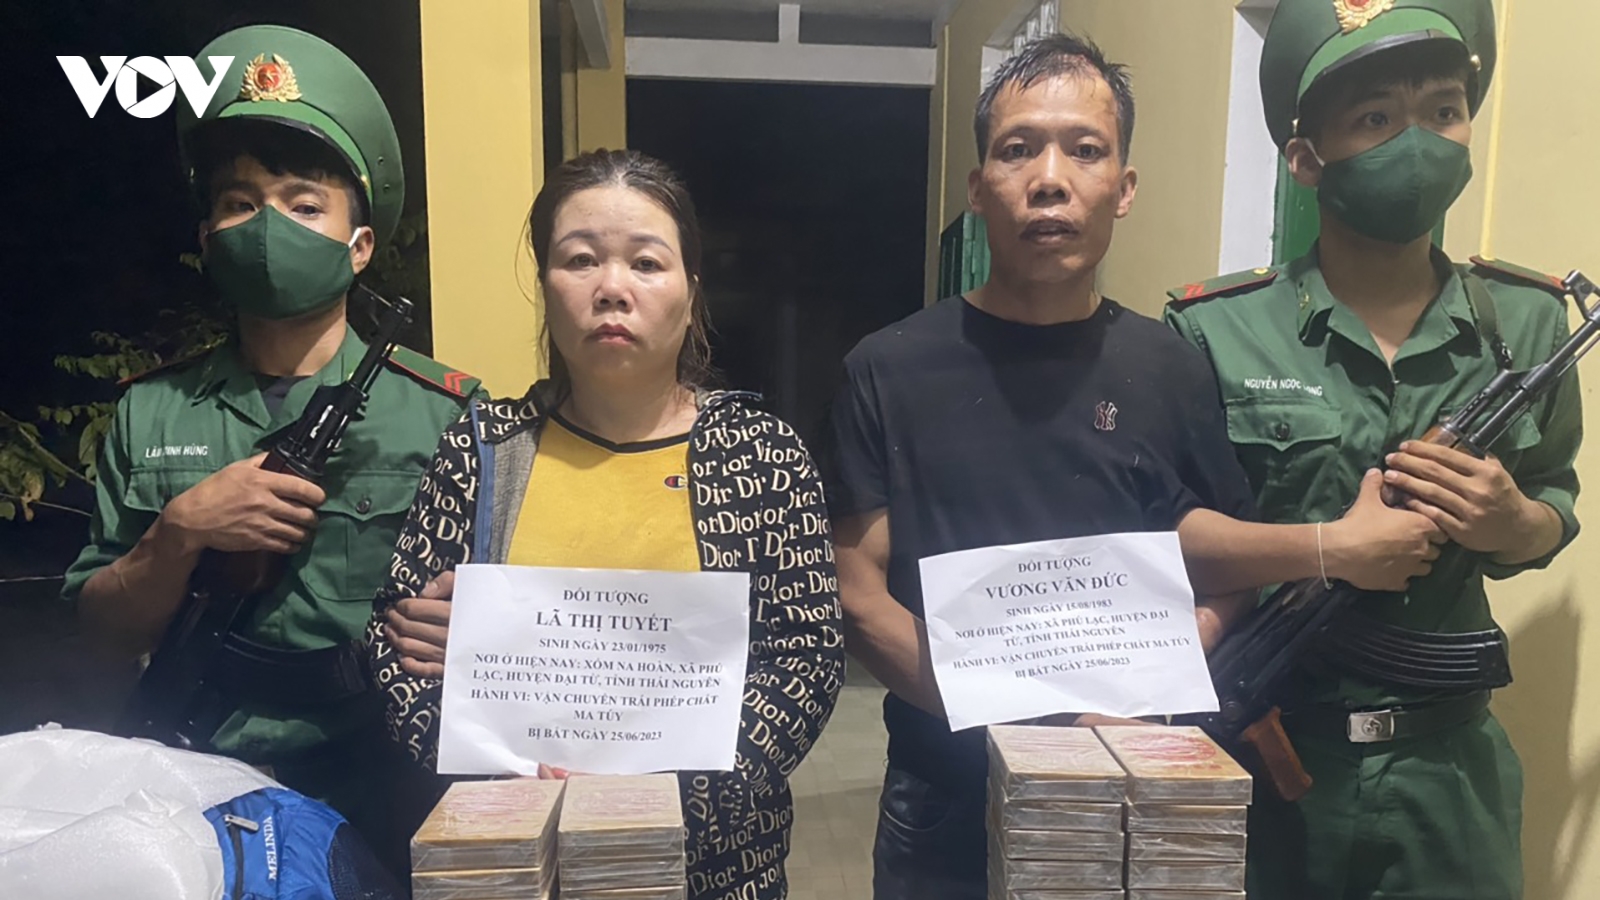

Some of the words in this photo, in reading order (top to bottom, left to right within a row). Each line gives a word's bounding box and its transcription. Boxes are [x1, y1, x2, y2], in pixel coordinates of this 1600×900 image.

[1045, 556, 1092, 571] TƯỢNG
[986, 582, 1047, 599] VƯƠNG
[1051, 576, 1087, 593] VĂN
[1091, 571, 1128, 590] ĐỨC
[595, 589, 649, 606] TƯỢNG
[1006, 607, 1031, 618] SINH
[1033, 602, 1063, 615] NGÀY
[1066, 599, 1113, 613] 15/08/1983
[536, 608, 562, 627] LÃ
[568, 613, 602, 632] THỊ
[608, 613, 672, 632] TUYẾT
[955, 629, 975, 640] NƠI
[987, 625, 1014, 637] HIỆN
[1016, 621, 1042, 634] NAY:
[1044, 618, 1060, 629] XÃ
[1110, 611, 1148, 623] HUYỆN
[1053, 628, 1080, 641] THÁI
[1082, 625, 1126, 639] NGUYÊN
[539, 639, 570, 650] SINH
[573, 638, 608, 652] NGÀY
[611, 642, 667, 654] 23/01/1975
[953, 656, 983, 670] HÀNH
[984, 656, 999, 666] VI:
[1069, 642, 1095, 654] TRÁI
[1096, 641, 1122, 652] PHÉP
[1153, 639, 1169, 649] MA
[474, 653, 499, 664] NƠI
[502, 653, 514, 665] Ở
[515, 656, 548, 668] HIỆN
[551, 658, 581, 669] NAY:
[584, 658, 613, 671] XÓM
[617, 661, 634, 672] NA
[679, 662, 695, 674] XÃ
[1015, 669, 1026, 680] BỊ
[1051, 660, 1082, 674] NGÀY
[1085, 657, 1131, 669] 25/06/2023
[473, 670, 503, 682] LẠC,
[506, 671, 551, 685] HUYỆN
[639, 676, 669, 688] THÁI
[672, 676, 720, 689] NGUYÊN
[471, 687, 509, 701] HÀNH
[513, 691, 531, 702] VI:
[534, 692, 561, 705] VẬN
[621, 694, 650, 707] TRÁI
[653, 696, 684, 708] PHÉP
[573, 710, 594, 721] MA
[527, 727, 541, 740] BỊ
[572, 728, 608, 741] NGÀY
[611, 731, 662, 742] 25/06/2023
[263, 815, 278, 881] MELINDA
